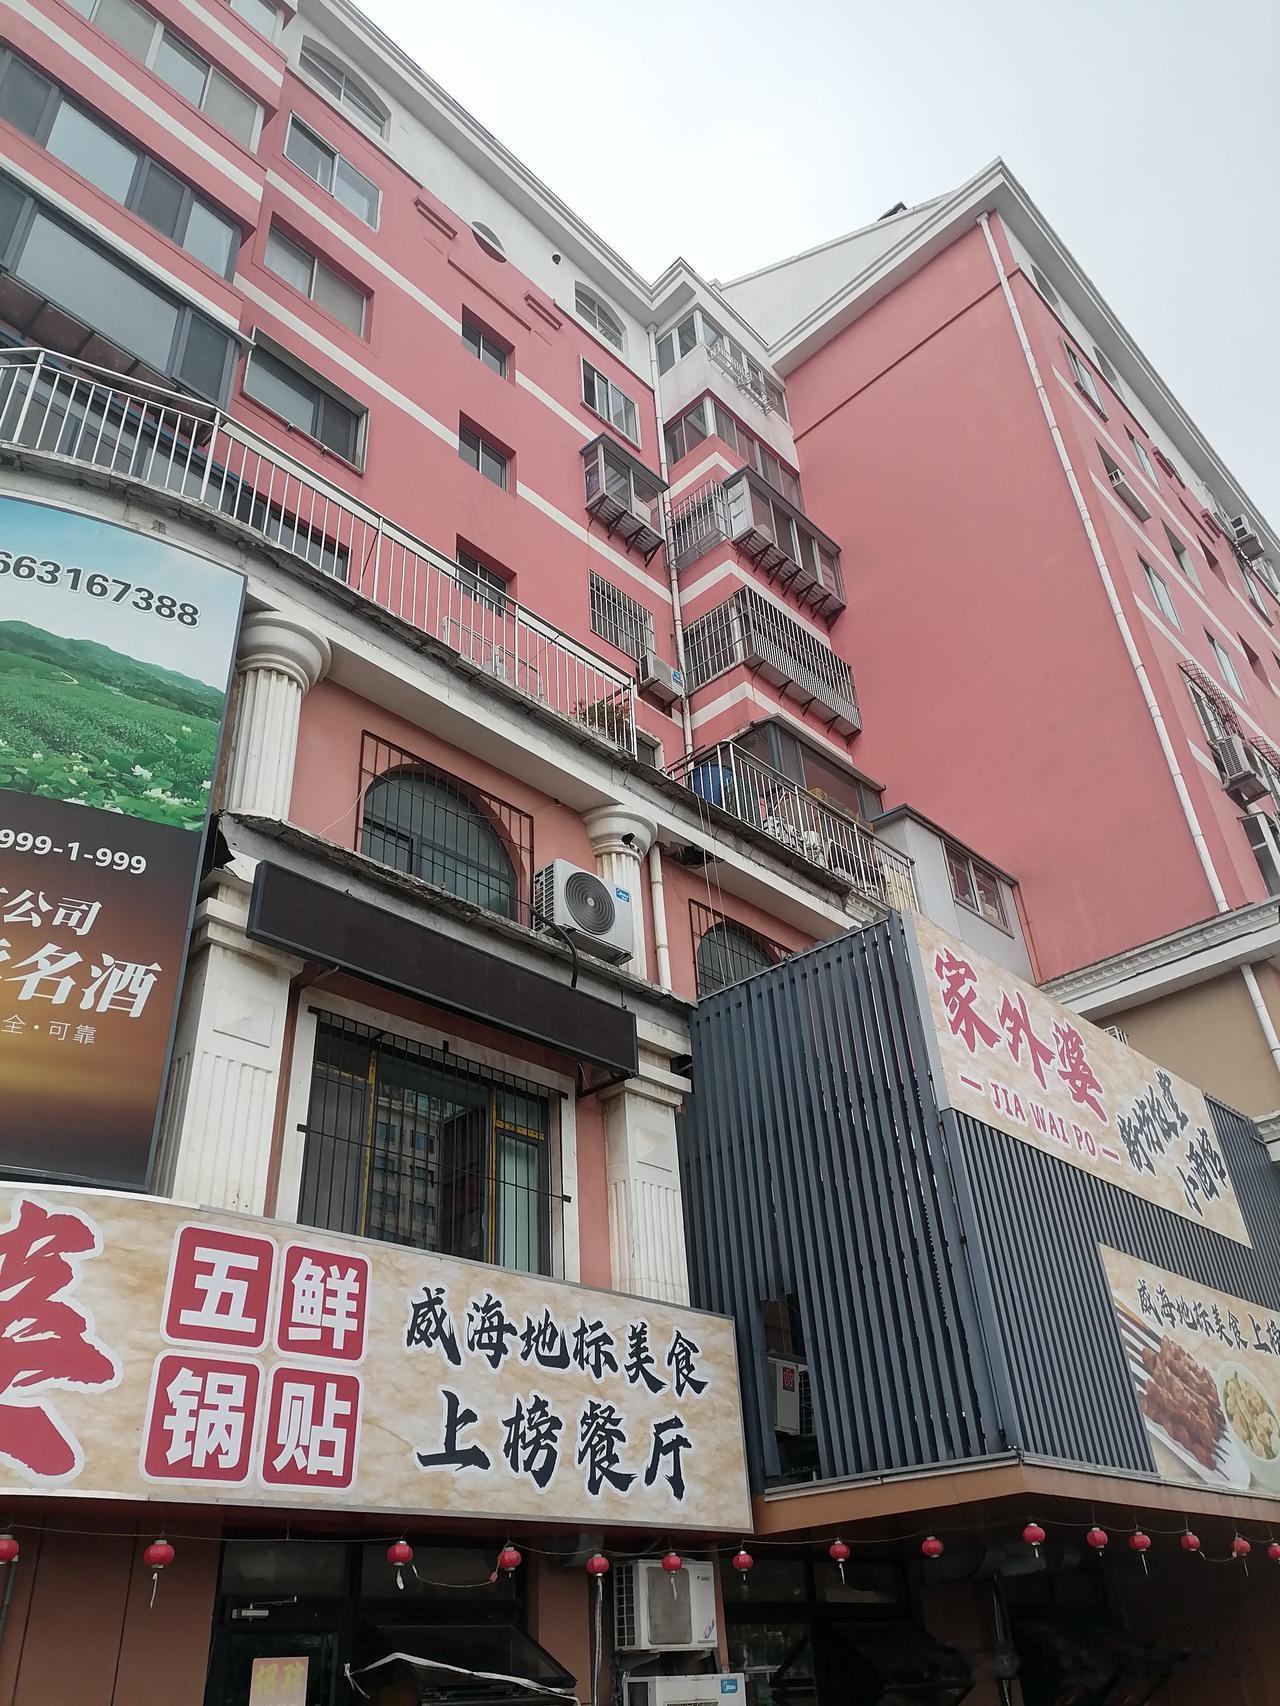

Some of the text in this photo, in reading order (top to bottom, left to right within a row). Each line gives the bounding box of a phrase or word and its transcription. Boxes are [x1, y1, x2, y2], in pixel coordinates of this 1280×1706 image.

[0, 829, 147, 874] 999-1-999
[0, 886, 103, 936] 公司
[0, 938, 163, 1018] 名酒
[934, 948, 1108, 1123] 家外婆
[990, 1083, 1096, 1157] JIA WAI PO
[406, 1286, 709, 1397] 威海地标美食
[416, 1389, 693, 1501] 上榜餐厅
